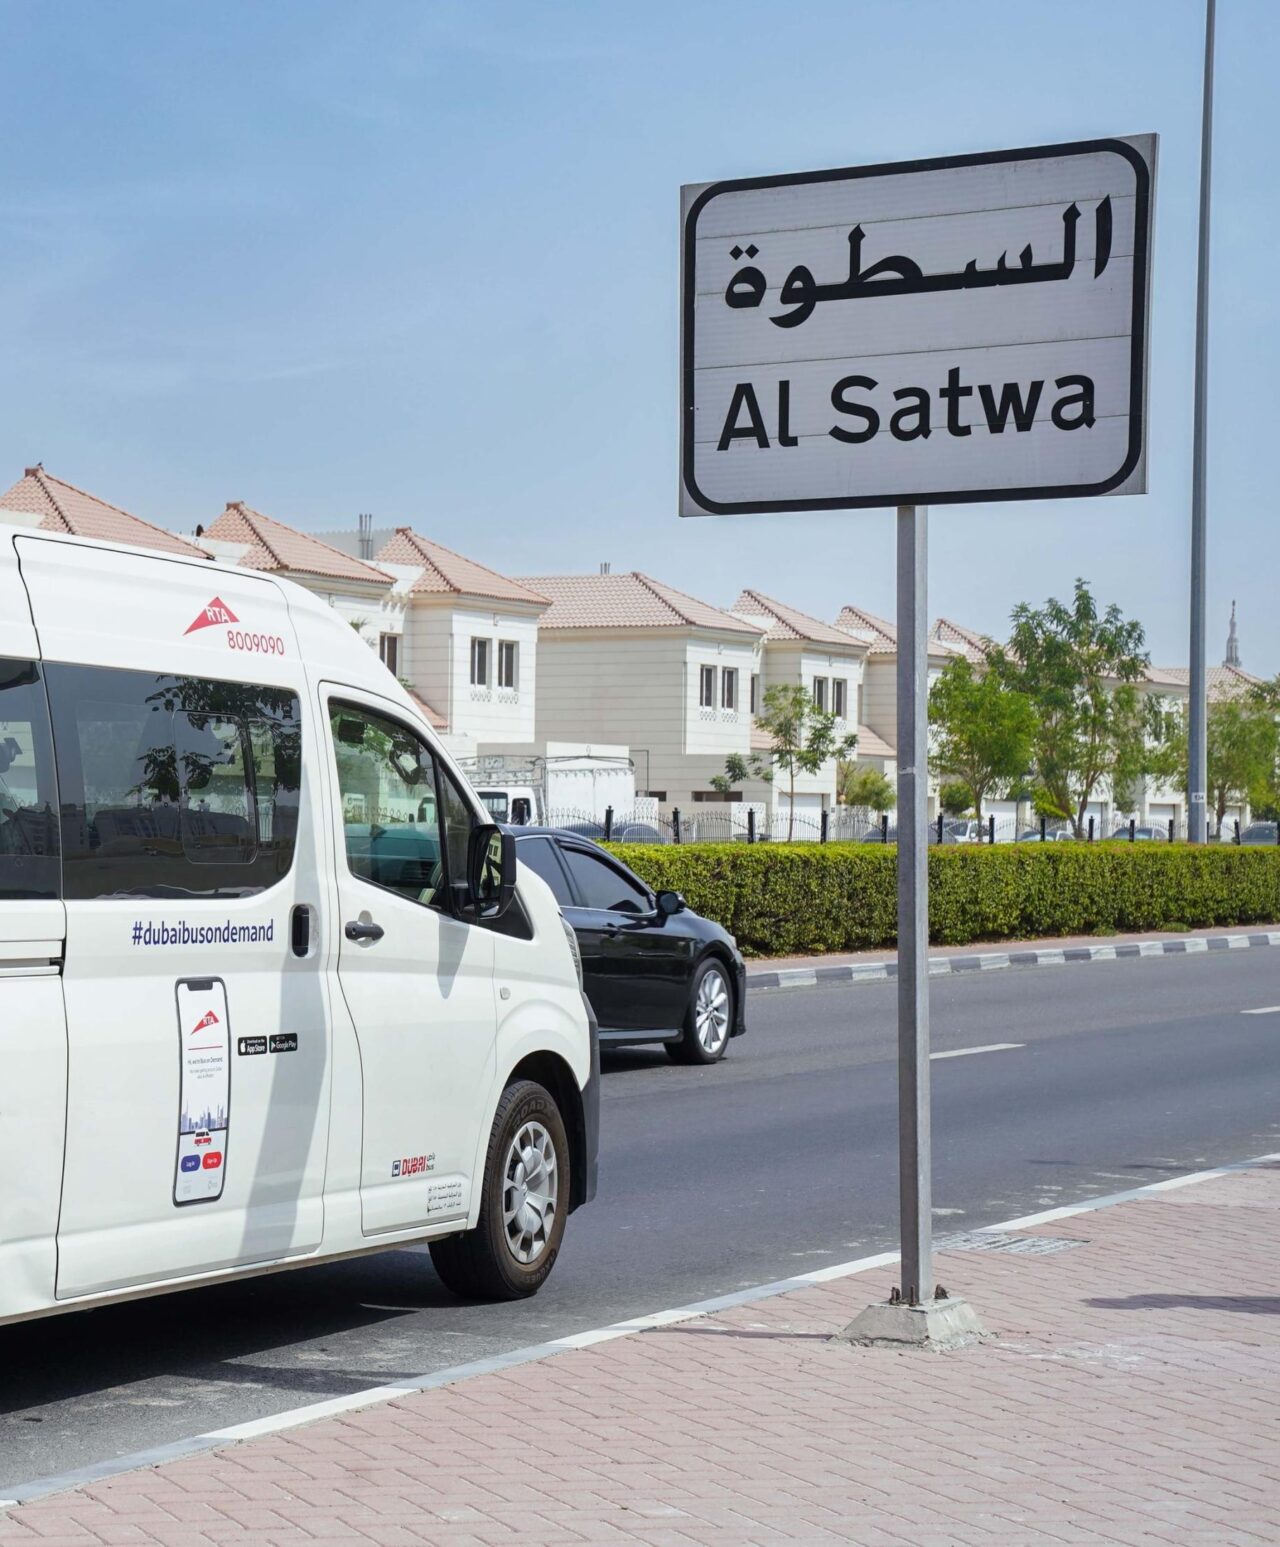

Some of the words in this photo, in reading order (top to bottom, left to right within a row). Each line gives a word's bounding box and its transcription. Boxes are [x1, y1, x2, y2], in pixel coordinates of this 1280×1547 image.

[724, 193, 1113, 329] السطوة
[716, 379, 799, 452] Al
[828, 366, 1097, 444] Satwa
[205, 606, 232, 624] RTA
[227, 630, 285, 656] 8009090
[132, 918, 274, 946] #dubaibusondemand
[247, 1044, 255, 1054] App
[255, 1043, 266, 1052] Store
[276, 1041, 288, 1050] Google
[288, 1040, 297, 1049] Play
